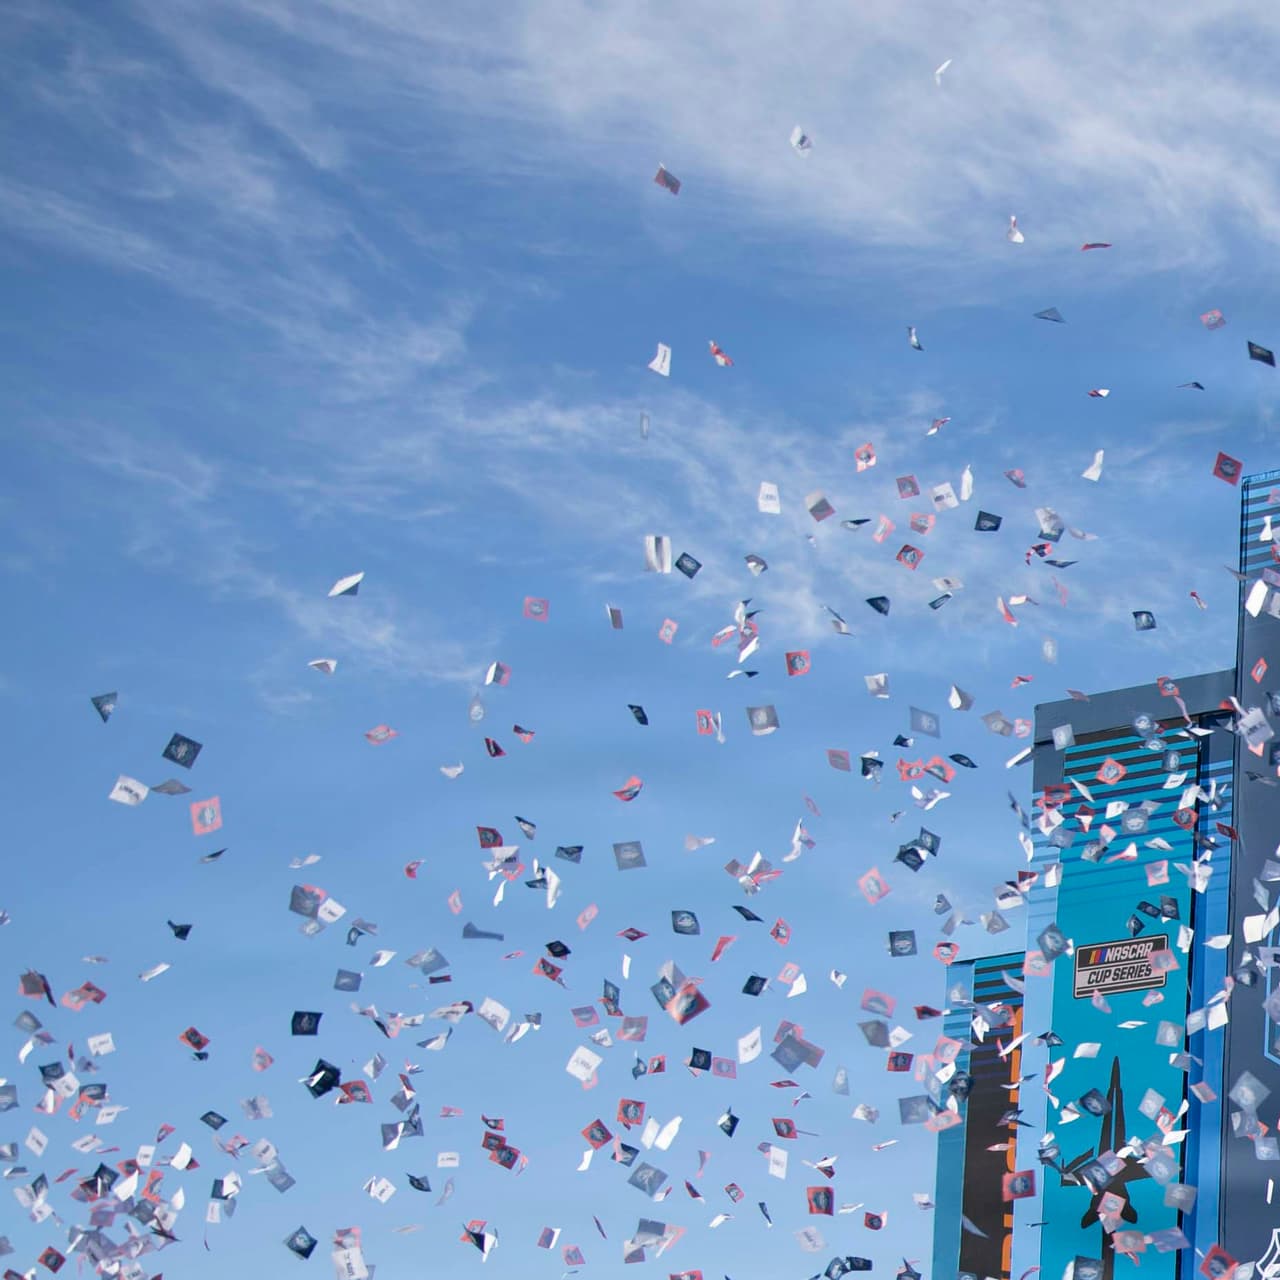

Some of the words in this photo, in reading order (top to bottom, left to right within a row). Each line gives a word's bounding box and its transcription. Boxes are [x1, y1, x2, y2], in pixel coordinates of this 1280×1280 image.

[1105, 942, 1154, 963] NASCAR
[1087, 970, 1112, 985] CUP
[1112, 964, 1153, 981] SERIES
